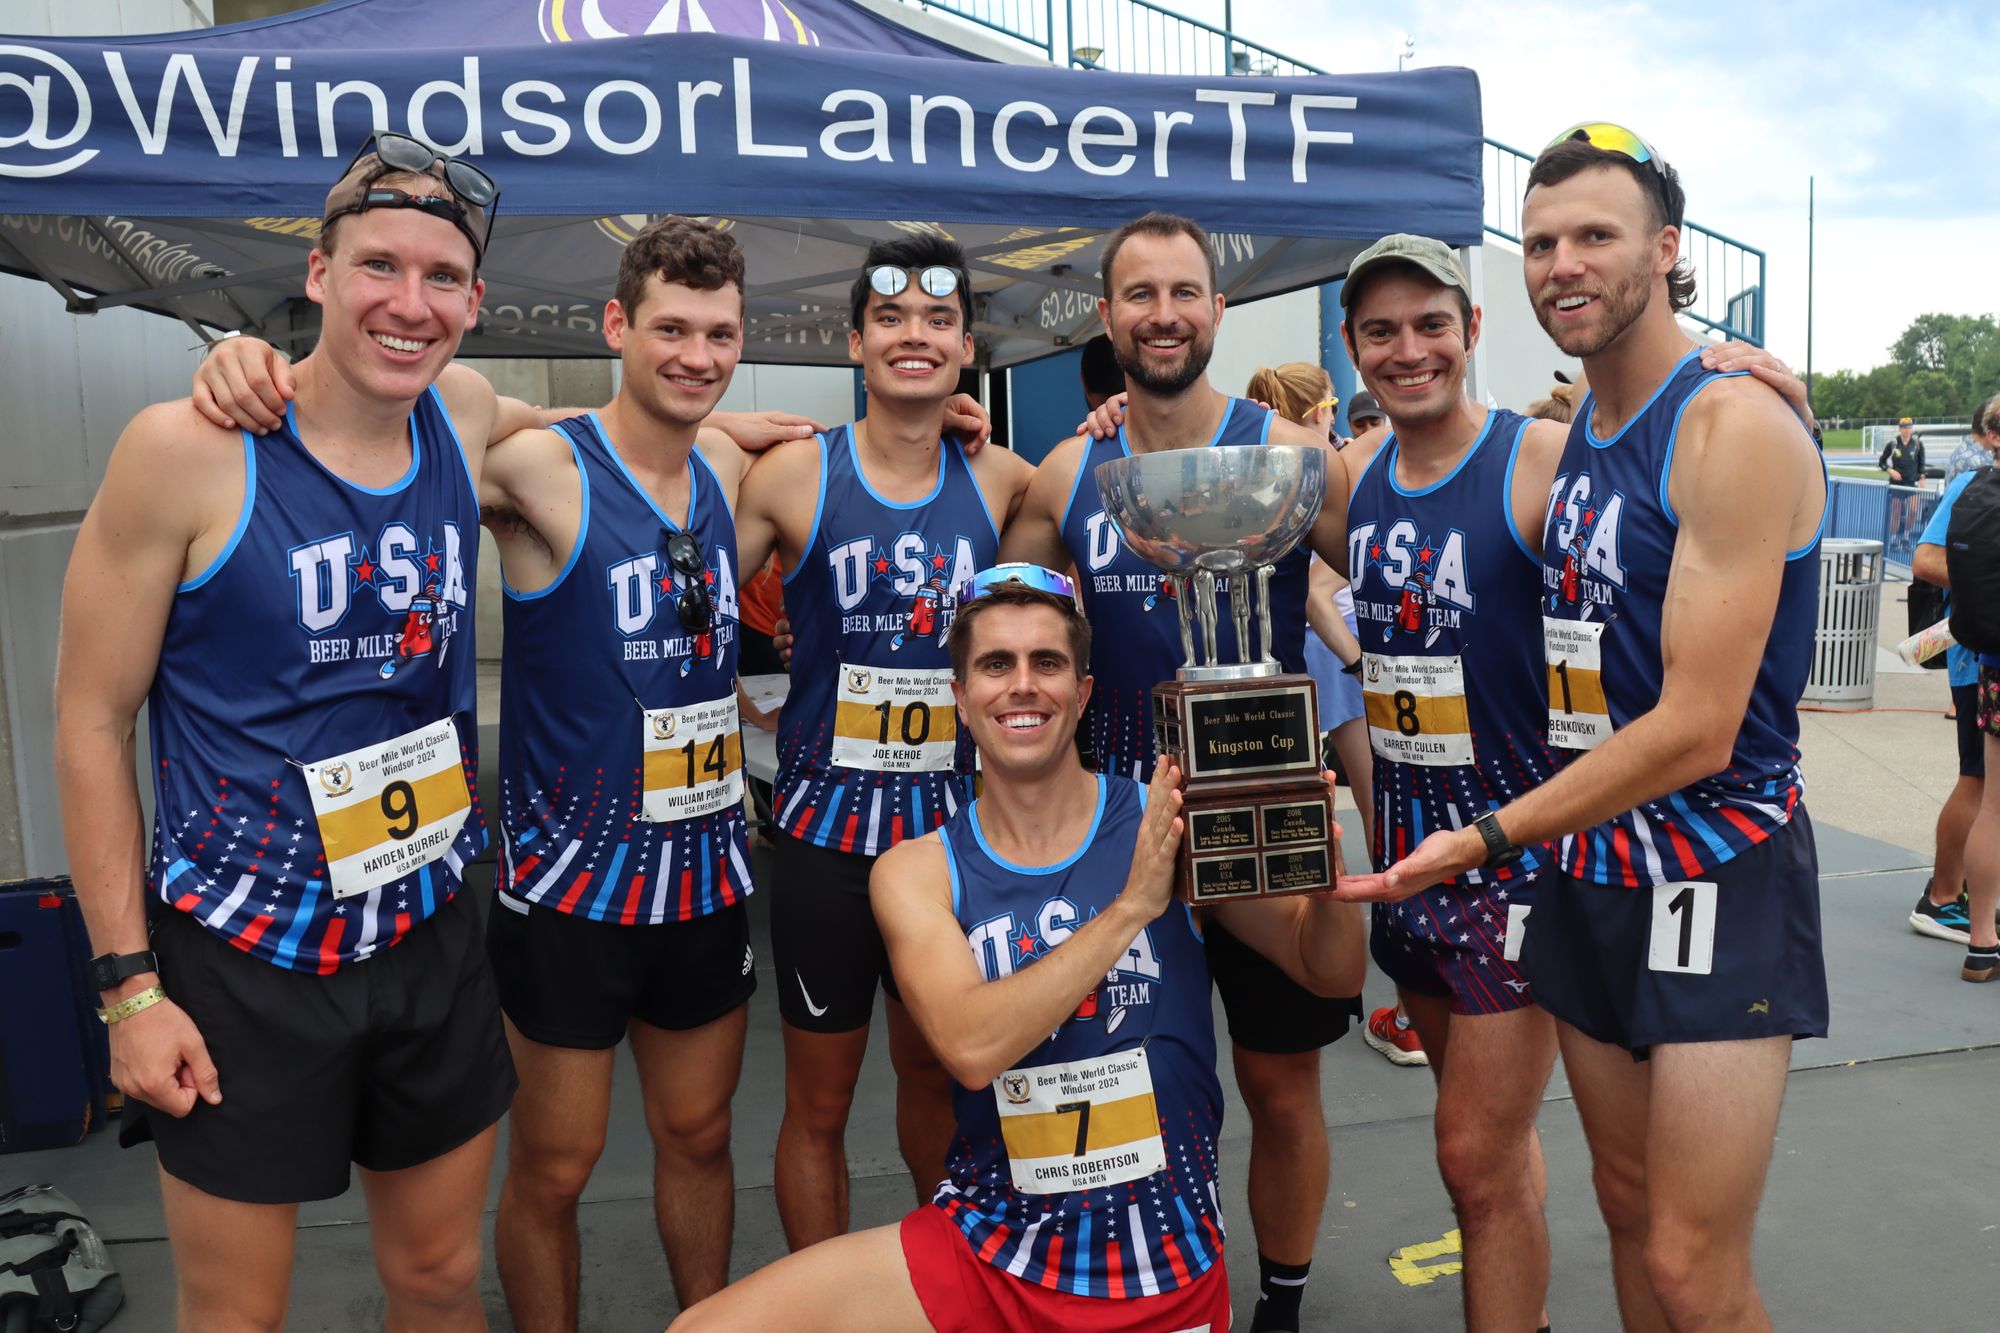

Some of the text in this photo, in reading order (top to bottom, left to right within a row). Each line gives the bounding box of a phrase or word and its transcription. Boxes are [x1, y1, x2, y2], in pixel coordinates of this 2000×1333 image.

[0, 44, 1358, 184] @WindsorLancerTF
[1093, 575, 1156, 593] BEER MILE
[1581, 578, 1614, 606] TEAM
[842, 615, 870, 634] BEER
[875, 613, 903, 632] MILE
[1371, 602, 1393, 622] MILE
[1427, 608, 1460, 628] TEAM
[1572, 630, 1592, 642] Classic
[309, 639, 350, 663] BEER
[355, 635, 393, 659] MILE
[624, 640, 659, 660] BEER
[663, 636, 692, 658] MILE
[1395, 665, 1409, 673] Mile
[1412, 665, 1428, 674] World
[1430, 666, 1454, 674] Classic
[878, 676, 894, 685] Beer
[896, 677, 911, 686] Mile
[913, 677, 931, 686] World
[1395, 676, 1421, 684] Windsor
[1555, 659, 1573, 715] 1
[895, 687, 922, 696] Windsor
[682, 714, 696, 723] Beer
[697, 711, 708, 720] Mile
[710, 708, 725, 718] World
[875, 700, 931, 746] 10
[1204, 710, 1296, 726] Beer Mile World Classic
[1394, 690, 1420, 737] 8
[697, 721, 718, 731] Windsor
[1549, 720, 1596, 735] BENKOVSKY
[1208, 734, 1295, 756] Kingston Cup
[1383, 737, 1446, 753] GARRETT CULLEN
[1555, 734, 1568, 743] MEN
[359, 731, 450, 772] Beer Mile World Classic
[681, 733, 727, 789] 14
[872, 749, 921, 760] JOE KEHOE
[382, 749, 436, 777] Windsor 2024
[668, 791, 704, 807] WILLIAM
[684, 799, 721, 814] USA EMERGING
[381, 779, 419, 841] 9
[1212, 825, 1236, 833] Canada
[363, 828, 450, 874] HAYDEN BURRELL
[396, 853, 427, 873] USA MEN
[1218, 862, 1233, 870] 2017
[1668, 887, 1695, 968] 1
[1107, 982, 1150, 1006] TEAM
[1037, 1060, 1138, 1087] Beer Mile World Classic
[1061, 1077, 1120, 1096] Windsor 2024
[1055, 1100, 1091, 1158] 7
[1035, 1151, 1140, 1180] CHRIS ROBERTSON
[1072, 1174, 1107, 1187] USA MEN
